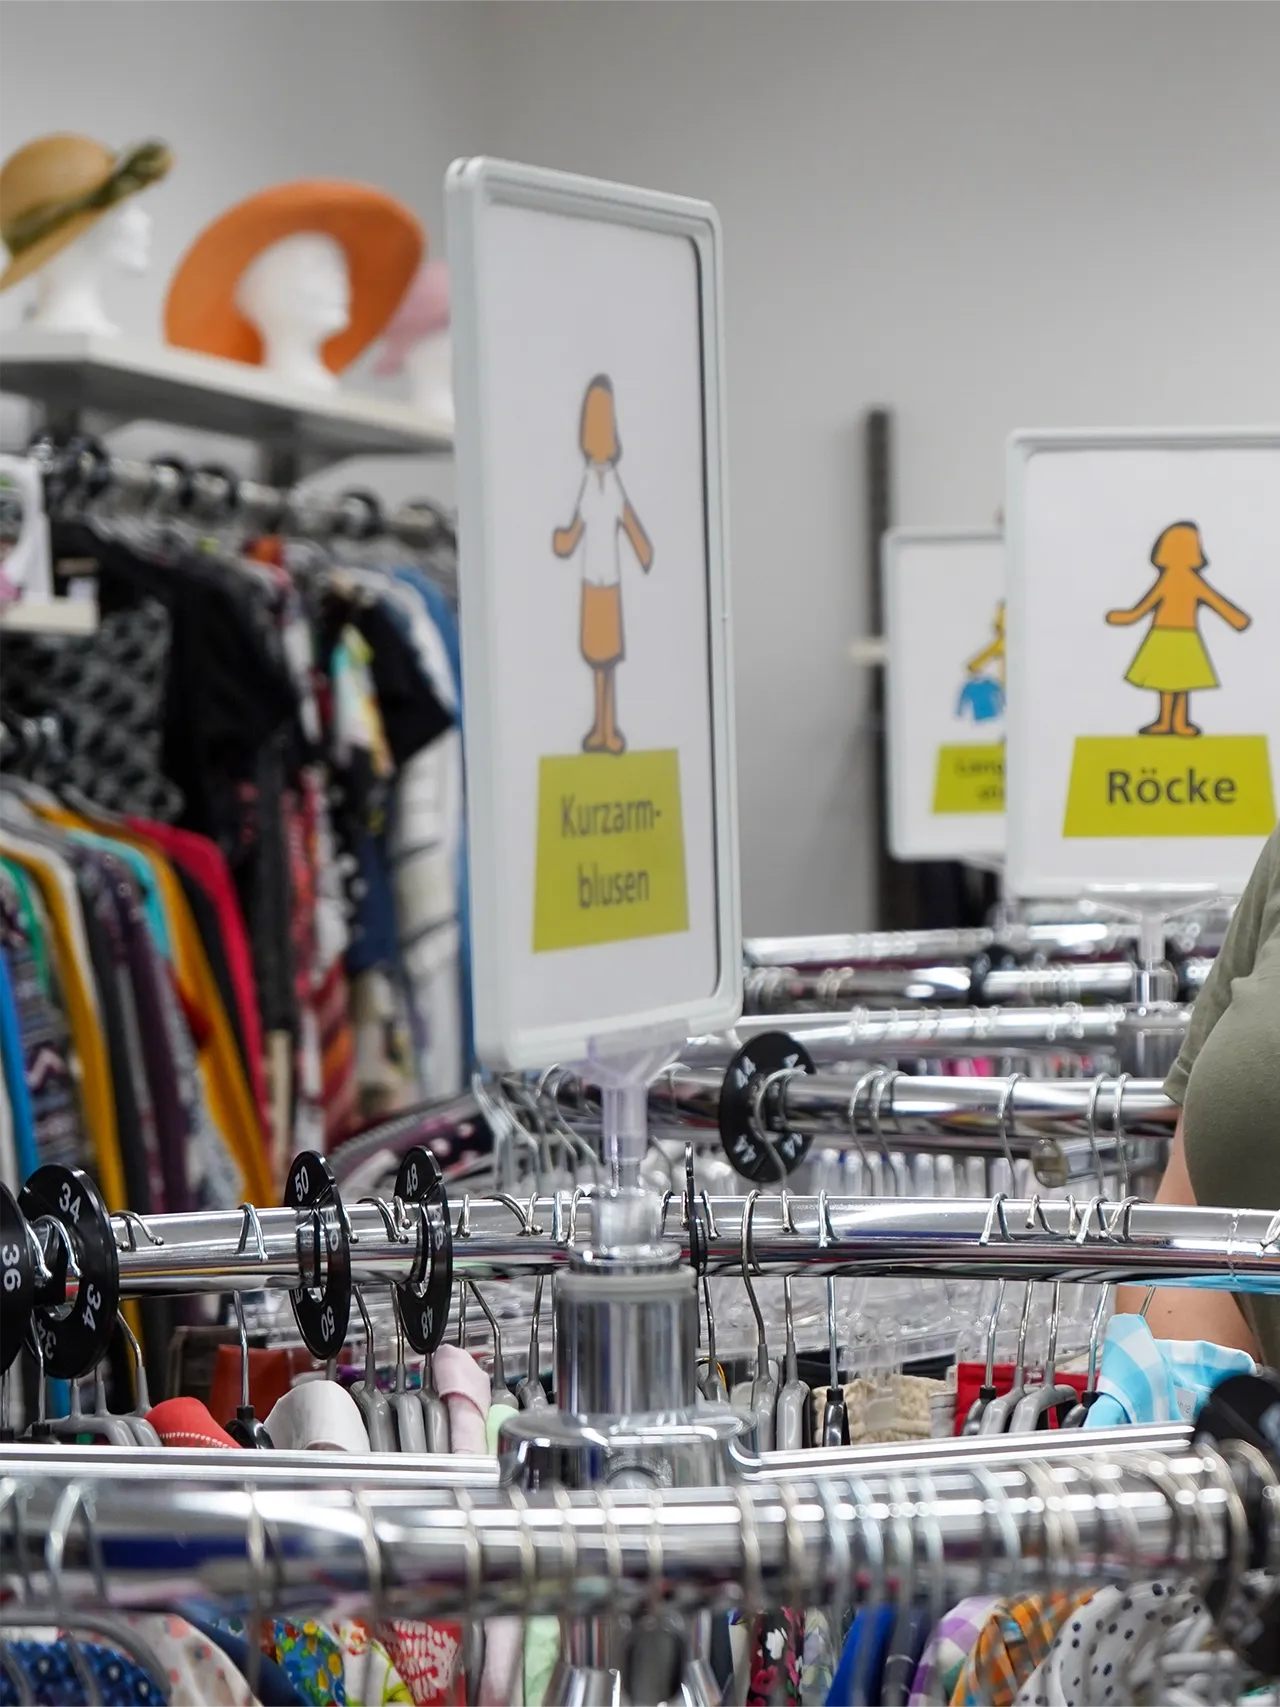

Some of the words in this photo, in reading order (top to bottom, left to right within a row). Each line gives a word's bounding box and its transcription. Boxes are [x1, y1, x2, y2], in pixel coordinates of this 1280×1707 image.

[1107, 767, 1238, 806] Röcke
[560, 793, 662, 839] Kurzarm-
[576, 862, 650, 910] blusen
[735, 1055, 757, 1090] 44
[734, 1133, 757, 1165] 44
[294, 1165, 310, 1202] 50
[405, 1162, 419, 1198] 48
[59, 1182, 82, 1225] 34
[1, 1243, 22, 1293] 36
[82, 1283, 102, 1332] 34
[320, 1304, 336, 1343] 50
[420, 1304, 434, 1340] 48
